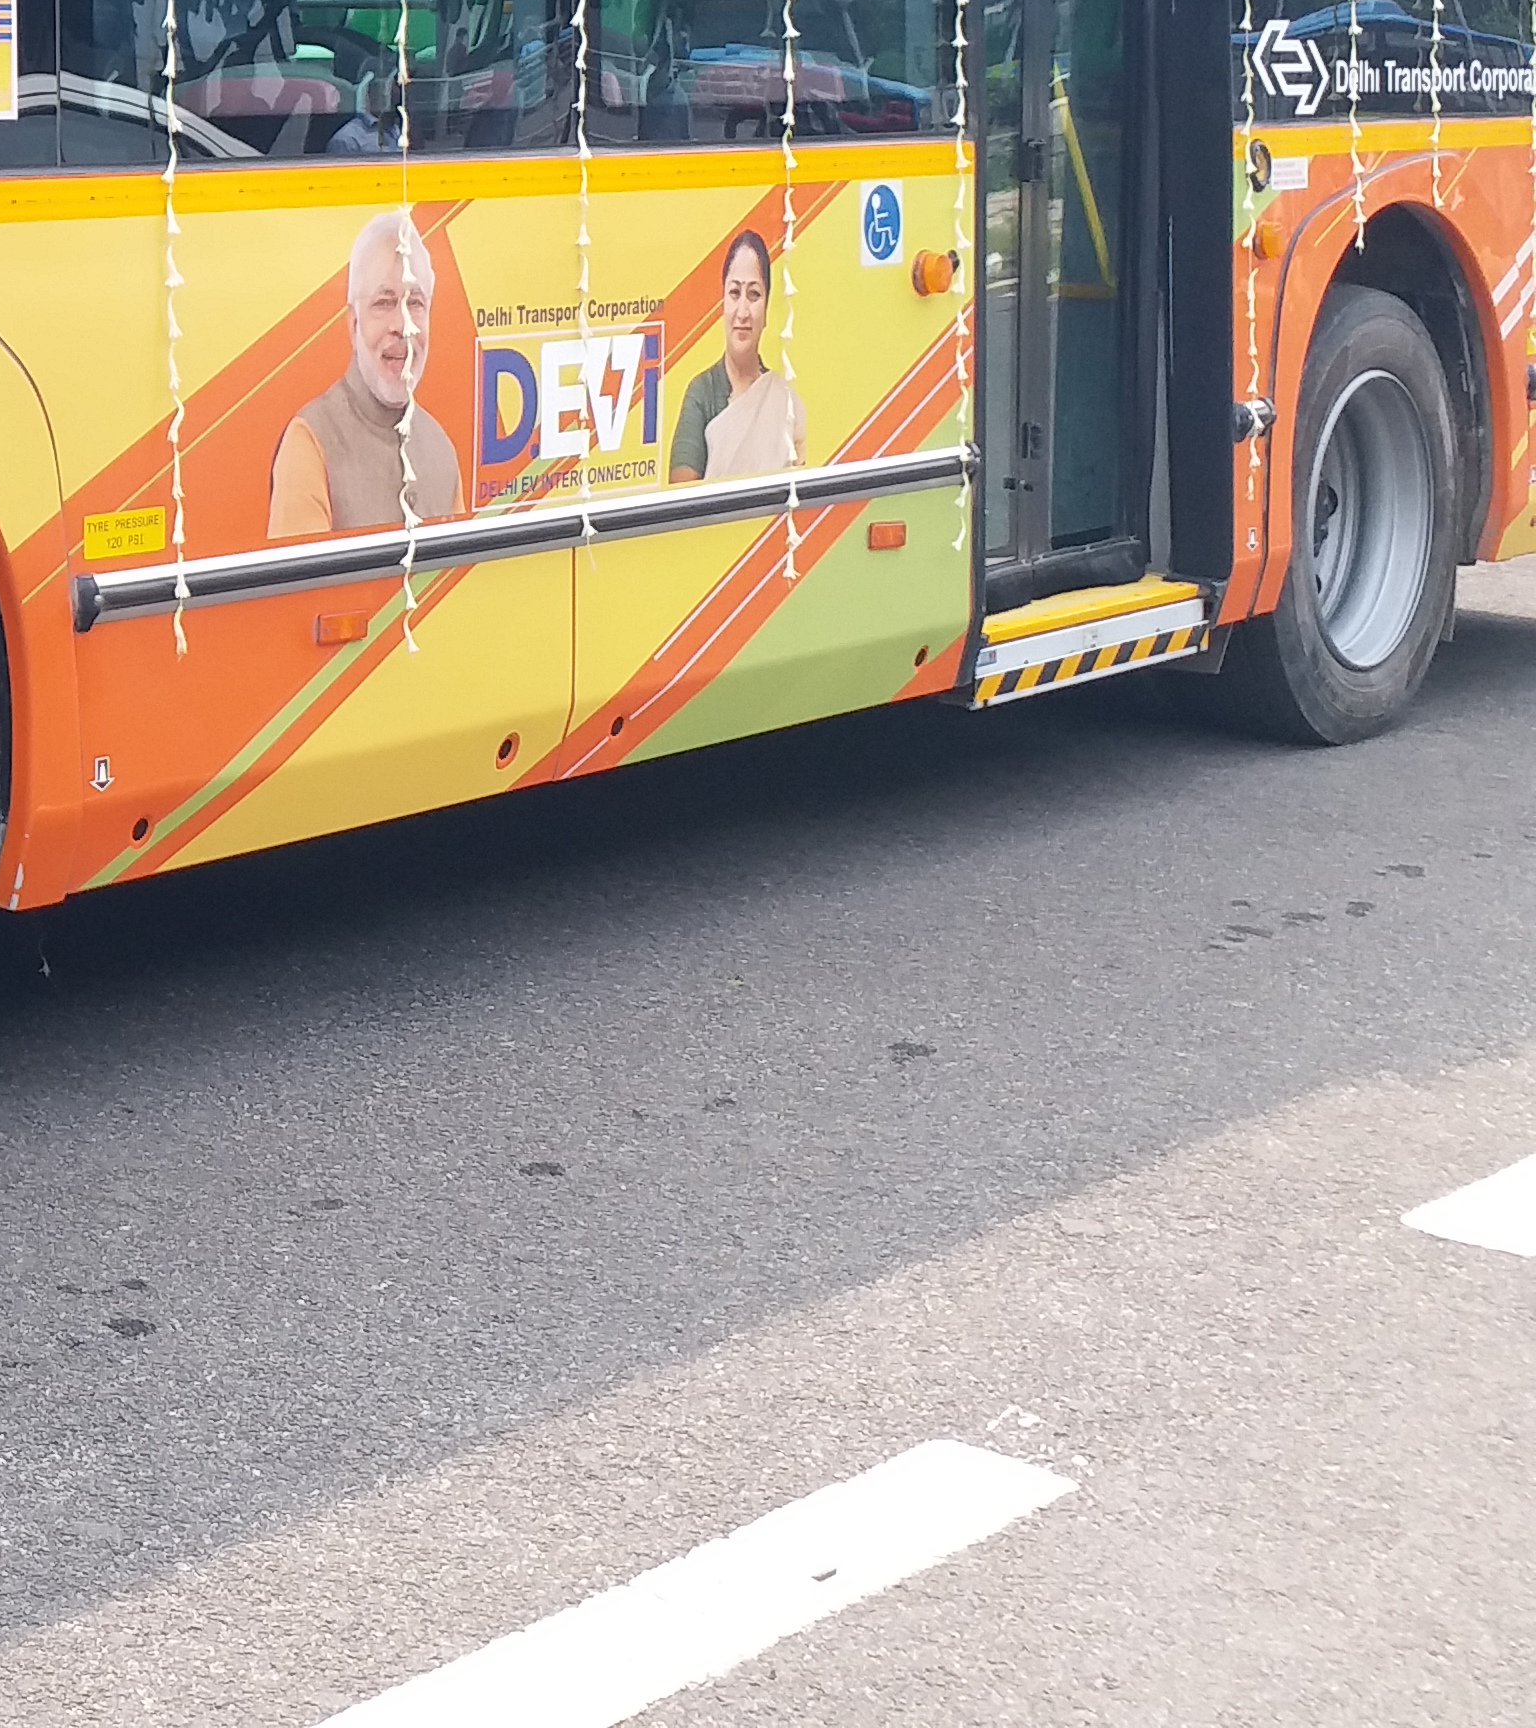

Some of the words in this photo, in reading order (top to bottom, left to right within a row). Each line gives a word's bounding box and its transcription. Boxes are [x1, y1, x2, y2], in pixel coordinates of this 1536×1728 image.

[1336, 59, 1379, 94] Delhi
[1384, 59, 1467, 95] Transport
[1470, 59, 1536, 100] Corpora
[477, 305, 512, 328] Delhi
[516, 302, 582, 327] Transpor
[588, 295, 664, 321] Corporation
[479, 477, 518, 500] DELHI
[522, 474, 539, 494] EV
[87, 520, 109, 533] TYRE
[115, 514, 159, 529] PRESSURE
[107, 536, 123, 549] 120
[128, 533, 144, 545] PSI
